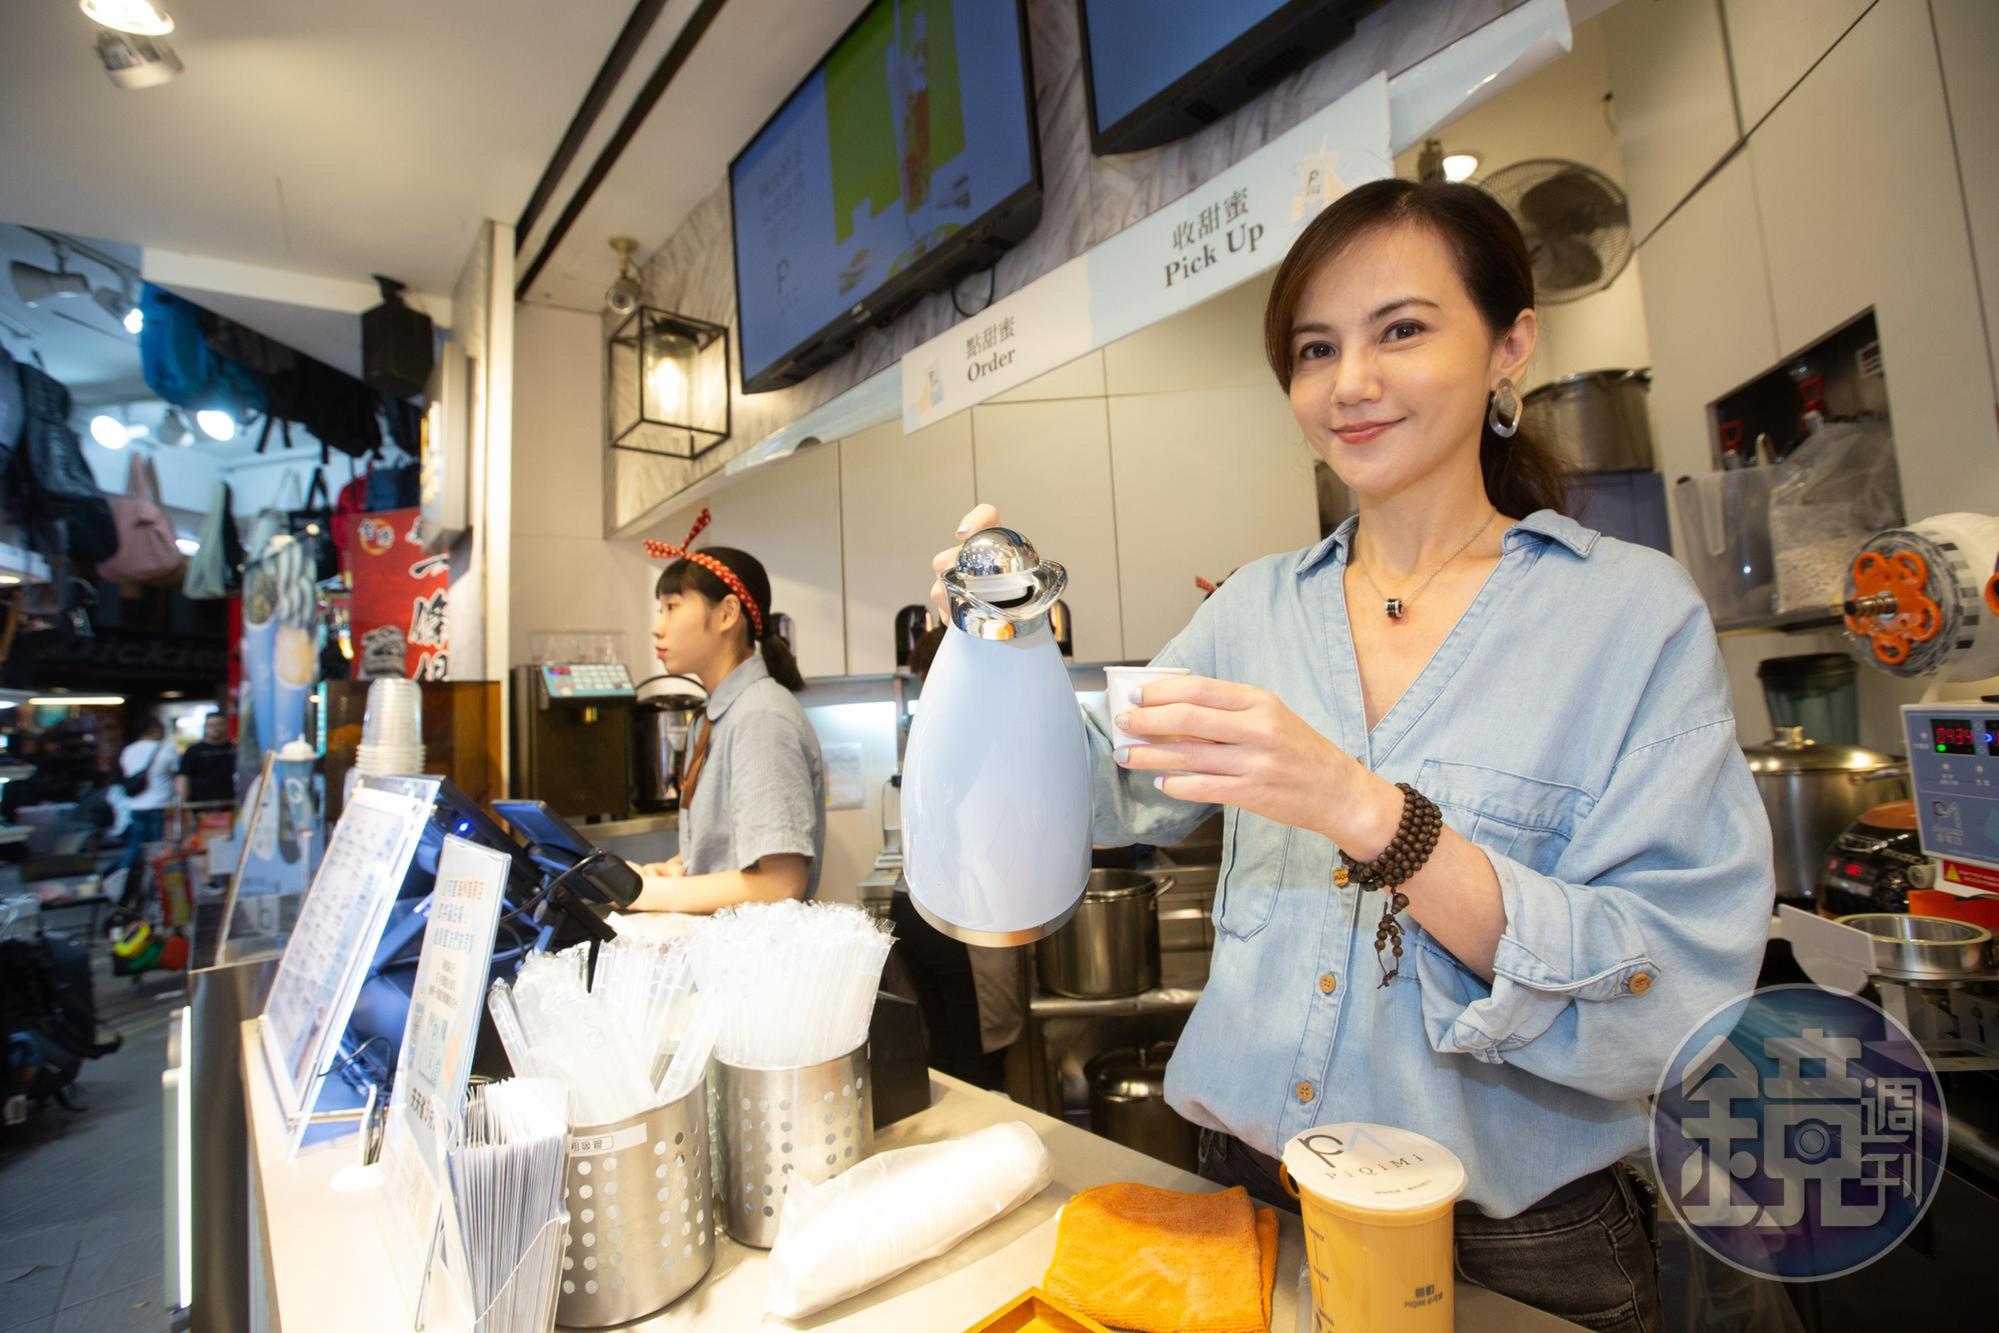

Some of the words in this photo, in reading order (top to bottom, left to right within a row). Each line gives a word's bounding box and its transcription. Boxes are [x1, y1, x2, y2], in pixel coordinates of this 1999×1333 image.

[1172, 187, 1249, 250] 收甜蜜
[1165, 244, 1218, 287] Pick
[1226, 223, 1265, 254] Up
[966, 316, 1015, 360] 點甜蜜
[967, 349, 1016, 383] Order
